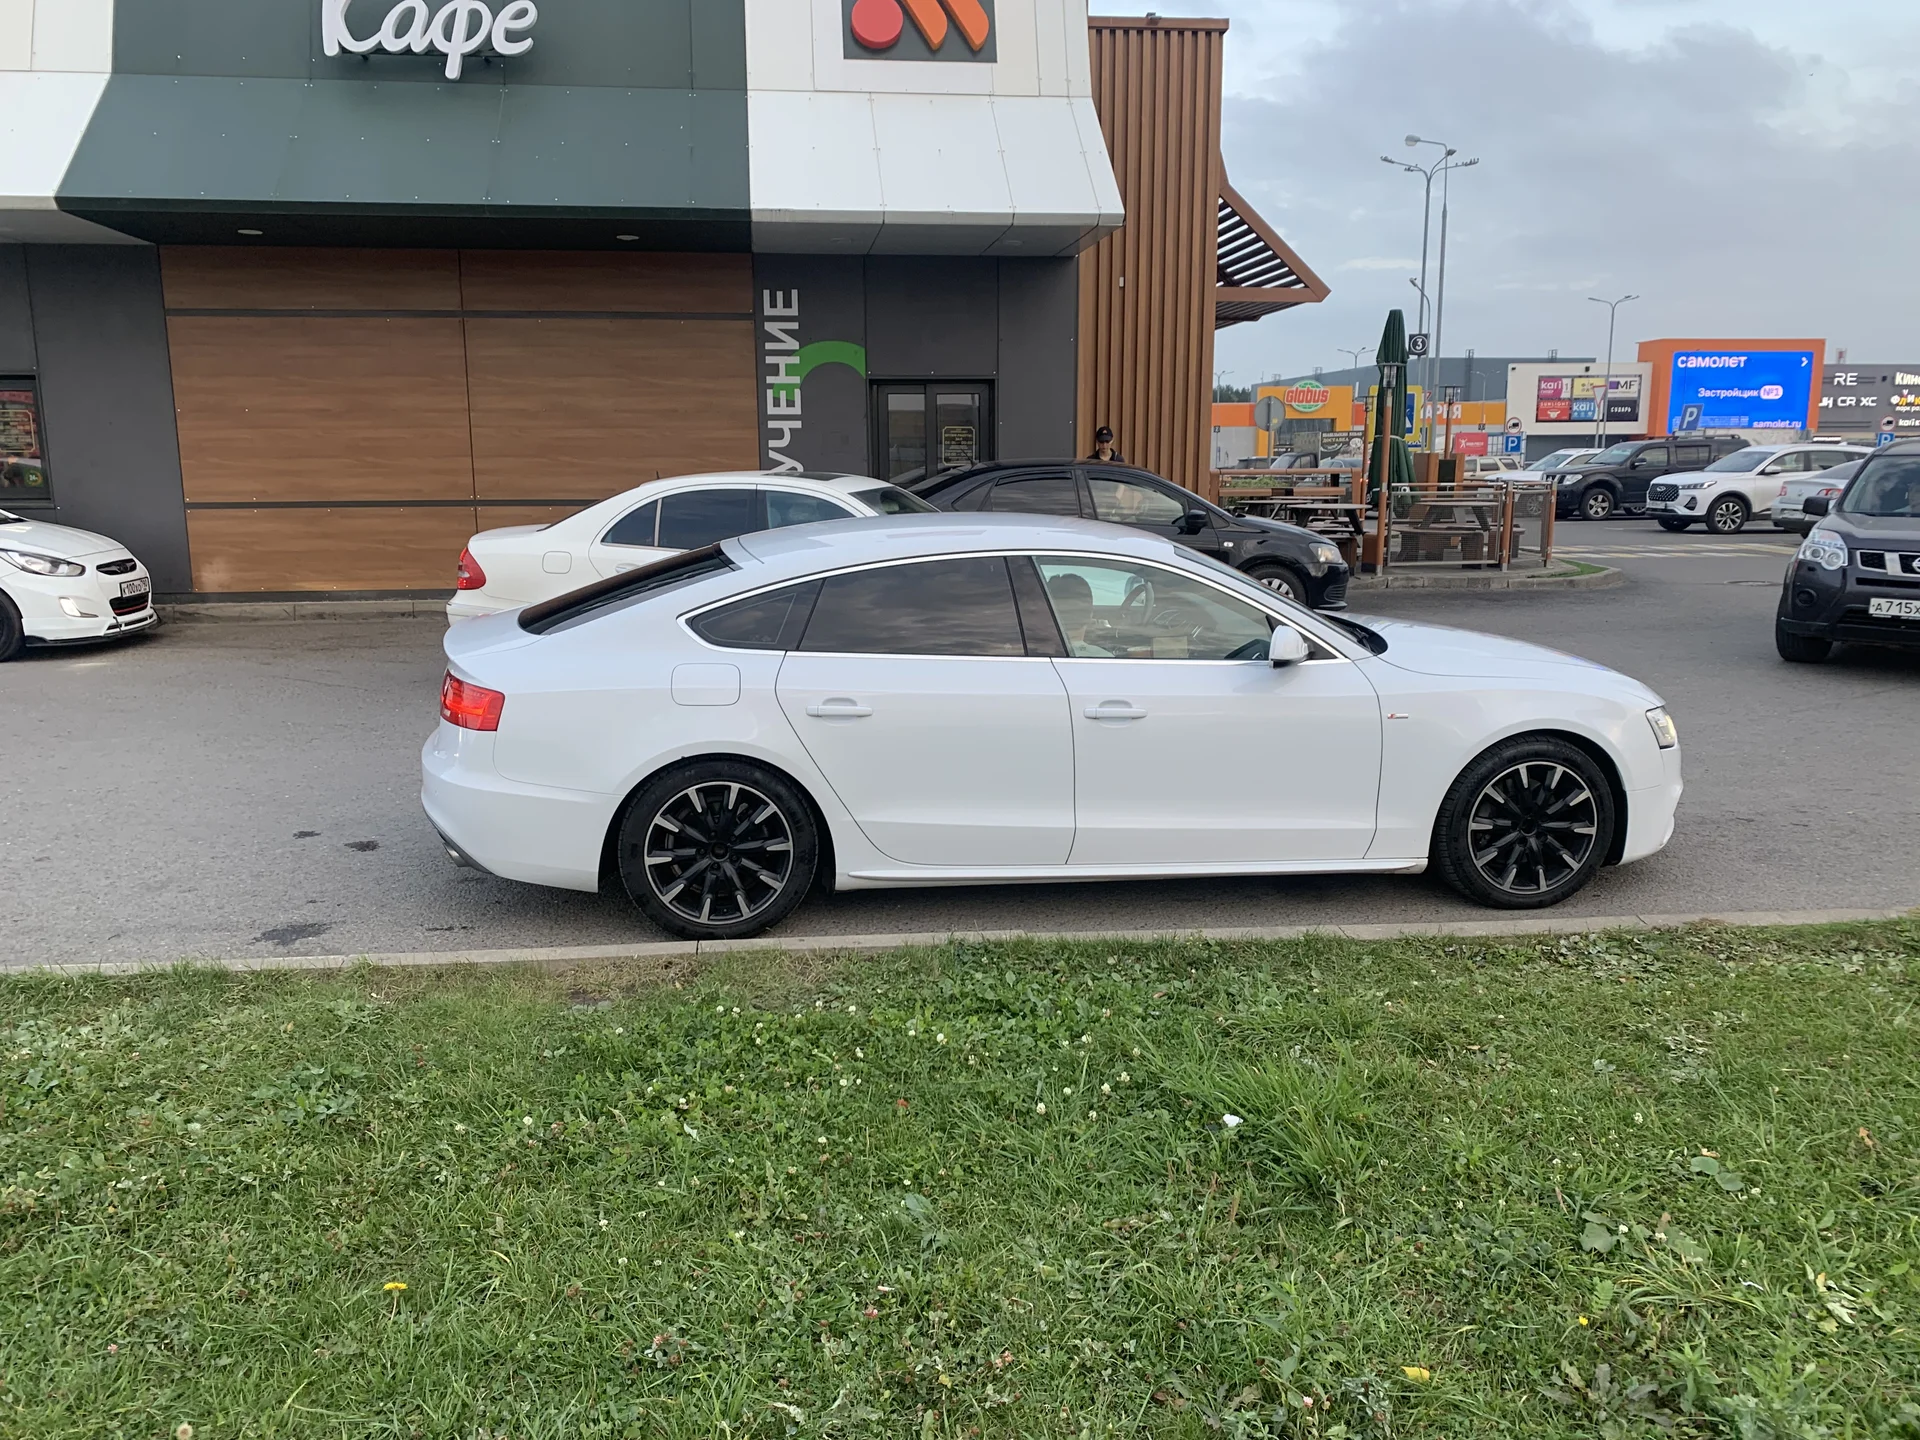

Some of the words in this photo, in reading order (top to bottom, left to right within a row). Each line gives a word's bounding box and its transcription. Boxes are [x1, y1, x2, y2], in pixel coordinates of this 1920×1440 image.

[321, 0, 537, 80] Кафе
[1416, 338, 1422, 350] 3
[1698, 387, 1759, 399] Застройщик
